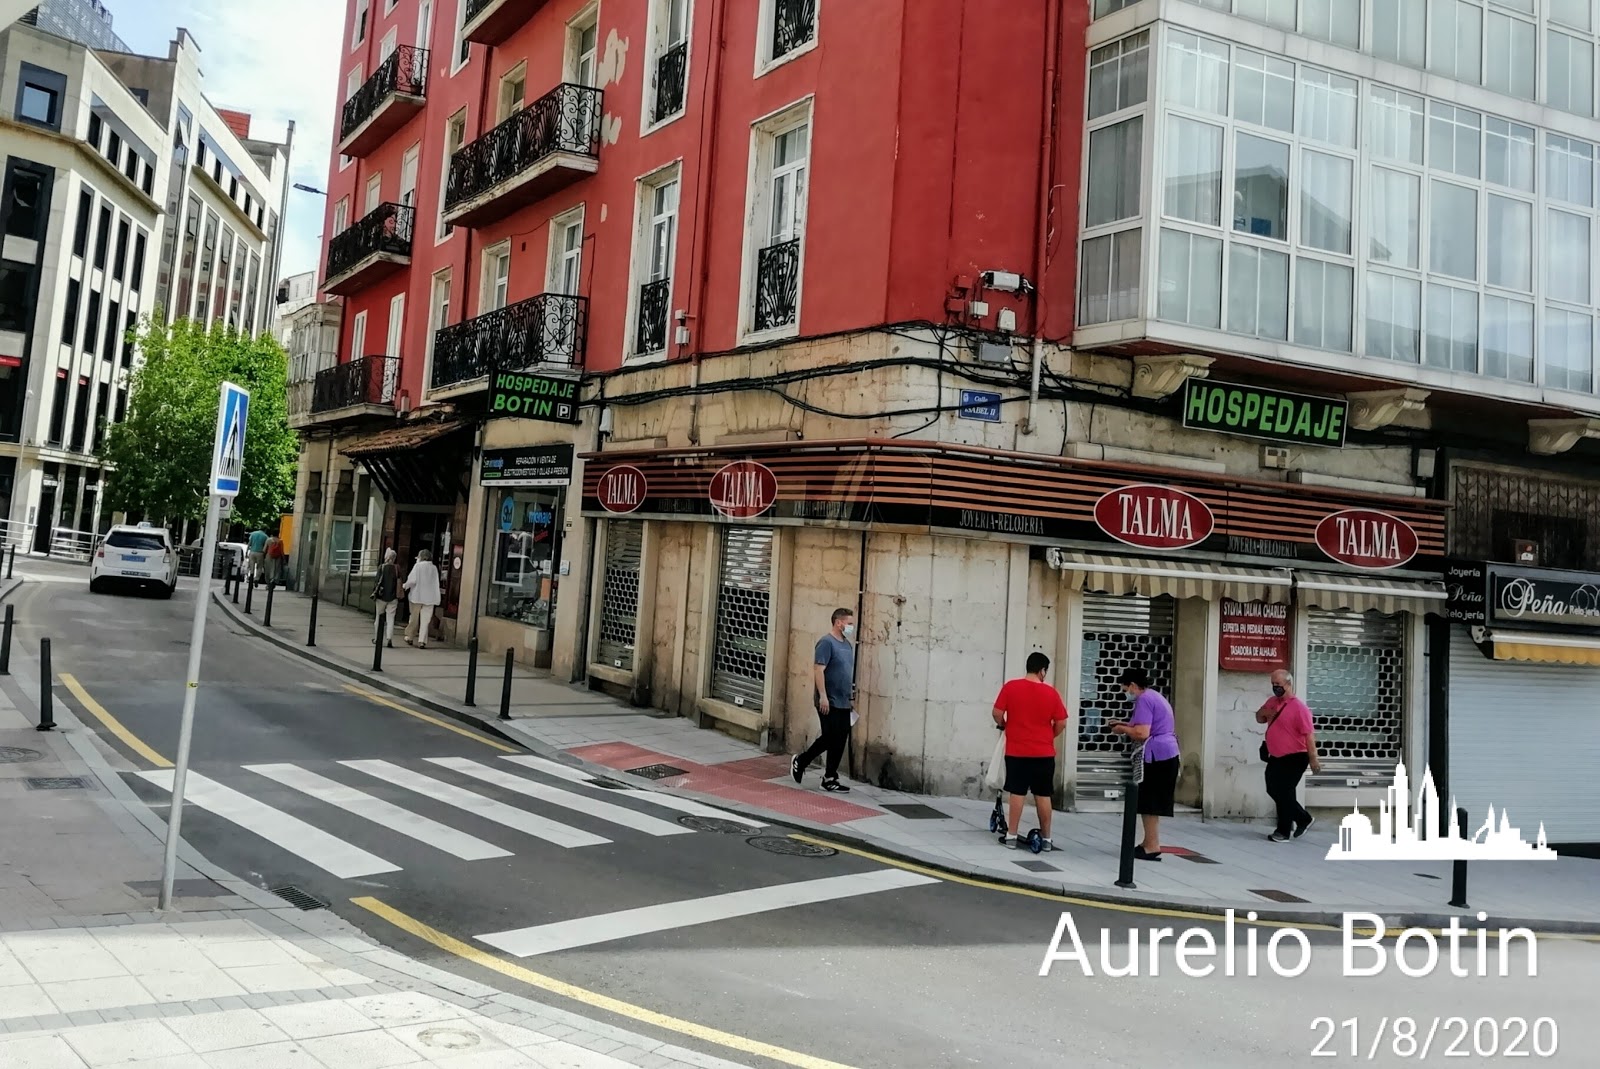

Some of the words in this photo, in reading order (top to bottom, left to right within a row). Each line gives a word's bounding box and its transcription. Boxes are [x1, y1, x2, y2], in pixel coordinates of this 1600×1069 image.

[496, 374, 575, 398] HOSPEDAJE
[494, 394, 552, 416] BOTIN
[1187, 386, 1344, 440] HOSPEDAJE
[607, 474, 637, 505] TALMA
[722, 471, 764, 508] TALMA
[1119, 493, 1194, 540] TALMA
[1335, 517, 1401, 560] TALMA
[1448, 566, 1481, 577] Joyería
[1447, 583, 1484, 602] Peña
[1501, 578, 1568, 617] Peña
[1243, 603, 1262, 617] TALMA
[1263, 604, 1287, 619] CHARLES
[1253, 647, 1259, 656] DE
